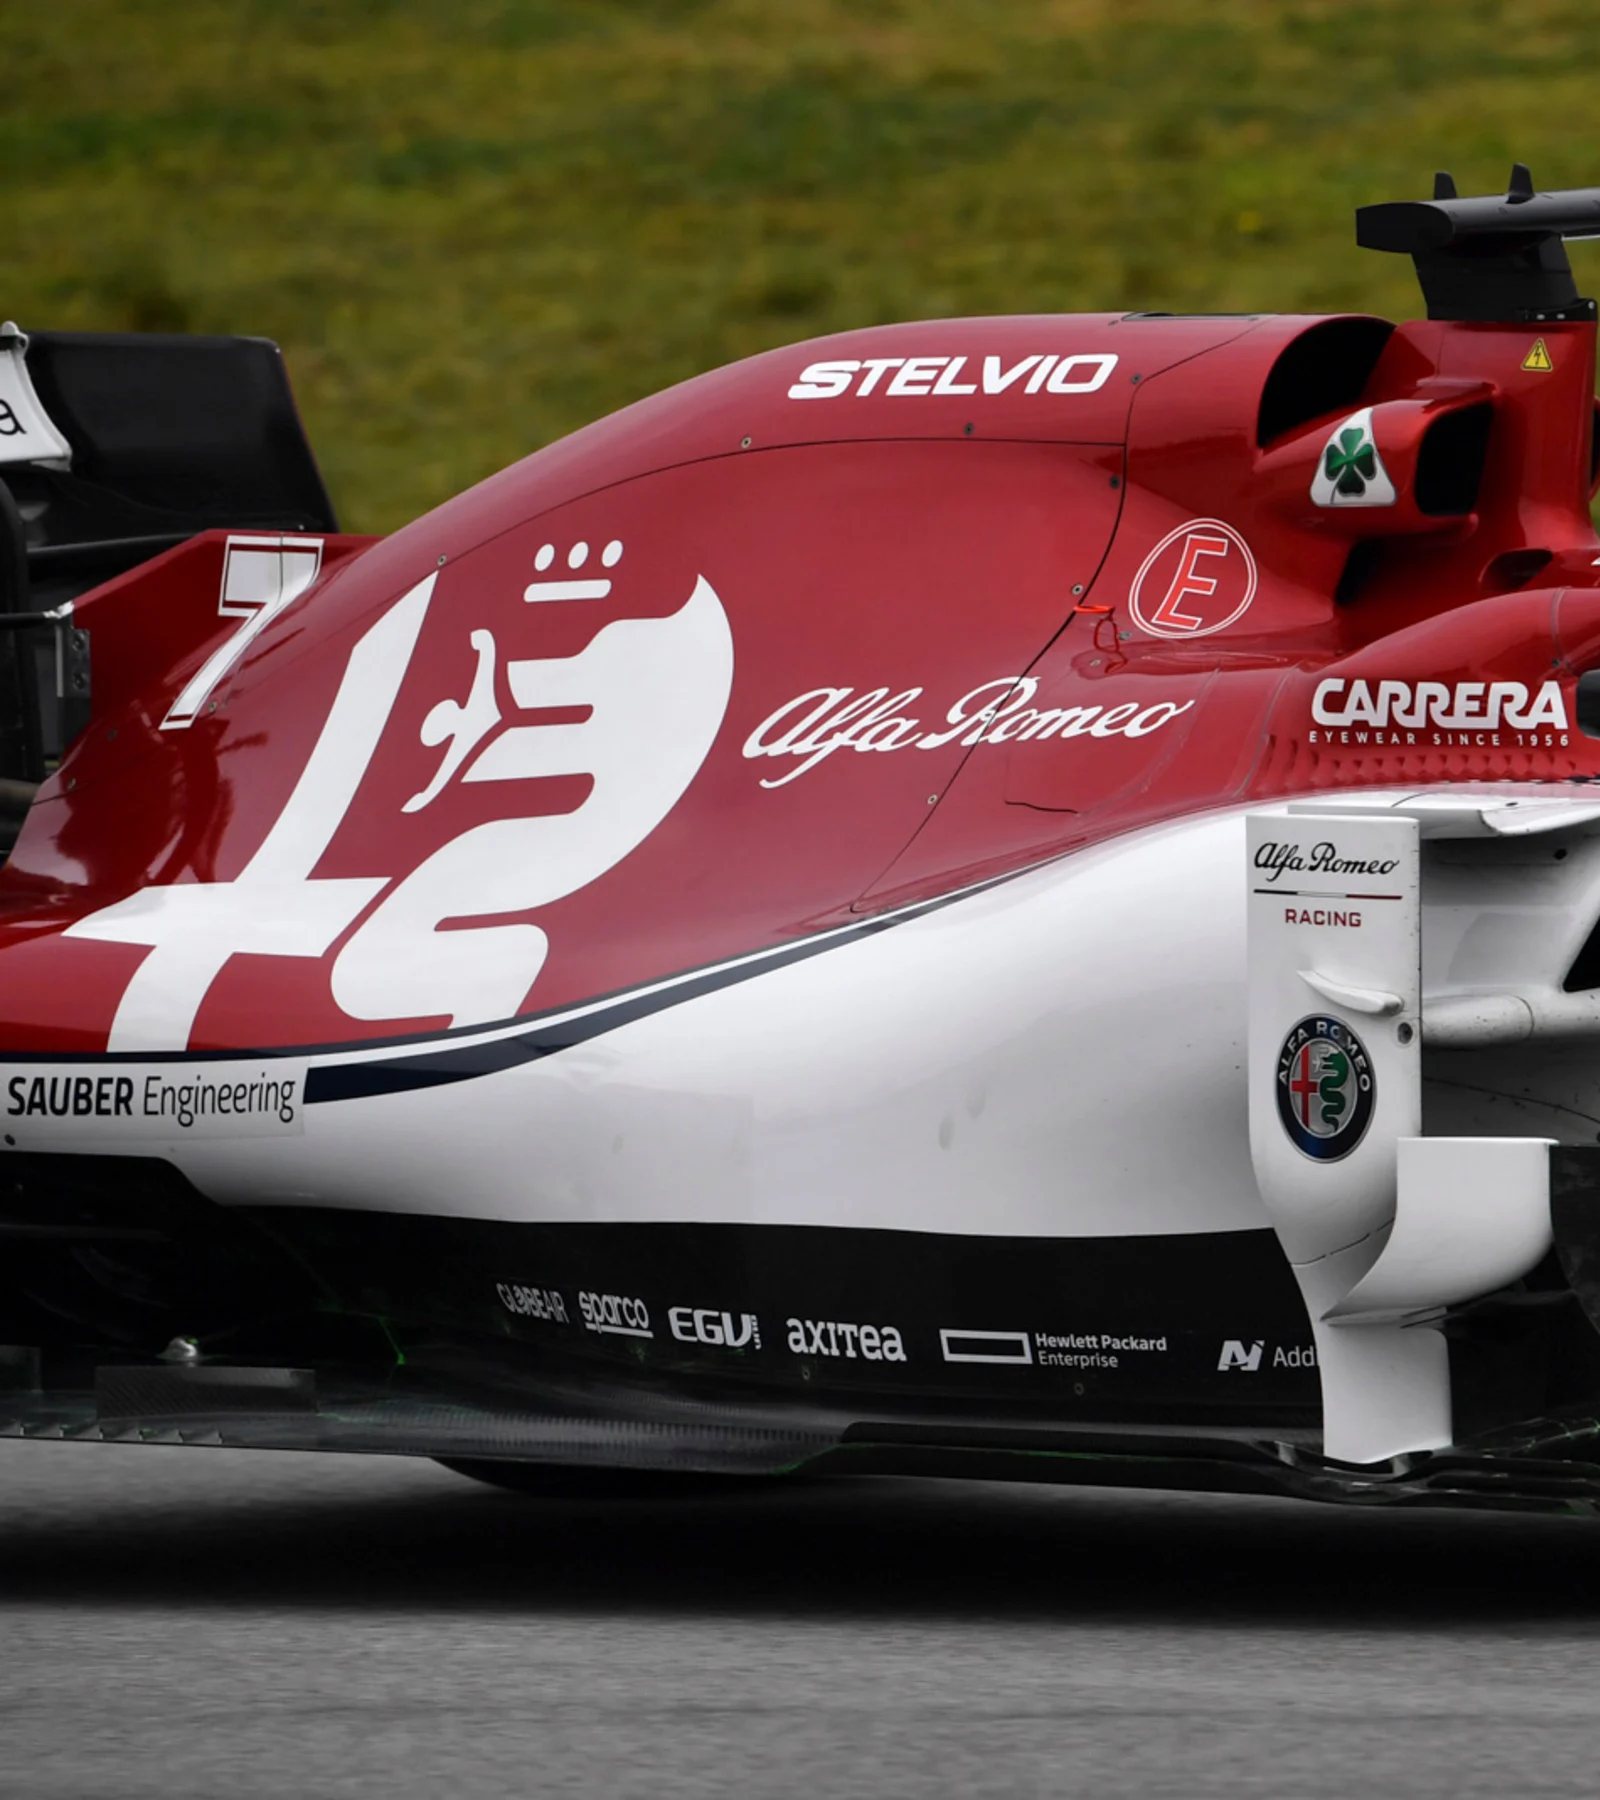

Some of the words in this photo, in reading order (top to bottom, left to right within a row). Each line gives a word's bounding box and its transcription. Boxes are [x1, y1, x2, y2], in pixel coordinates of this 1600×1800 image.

[788, 353, 1118, 399] STELVIO
[1151, 533, 1228, 630] E
[158, 534, 324, 730] 7
[1311, 678, 1568, 730] CARRERA
[742, 687, 923, 789] Alfa
[915, 676, 1195, 750] Romeo
[1309, 731, 1416, 745] EYEWEAR
[1433, 733, 1500, 746] SINCE
[1517, 734, 1570, 747] 1956
[1254, 842, 1307, 882] Alfa
[1308, 842, 1400, 874] Romeo
[1285, 908, 1362, 927] RACING
[1279, 1028, 1308, 1086] ALFA
[7, 1076, 134, 1116] SAUBER
[144, 1072, 296, 1127] Engineering
[578, 1291, 649, 1334] sparco
[1035, 1332, 1099, 1349] Hewlett
[1101, 1335, 1167, 1351] Packard
[1038, 1350, 1119, 1369] Enterprise
